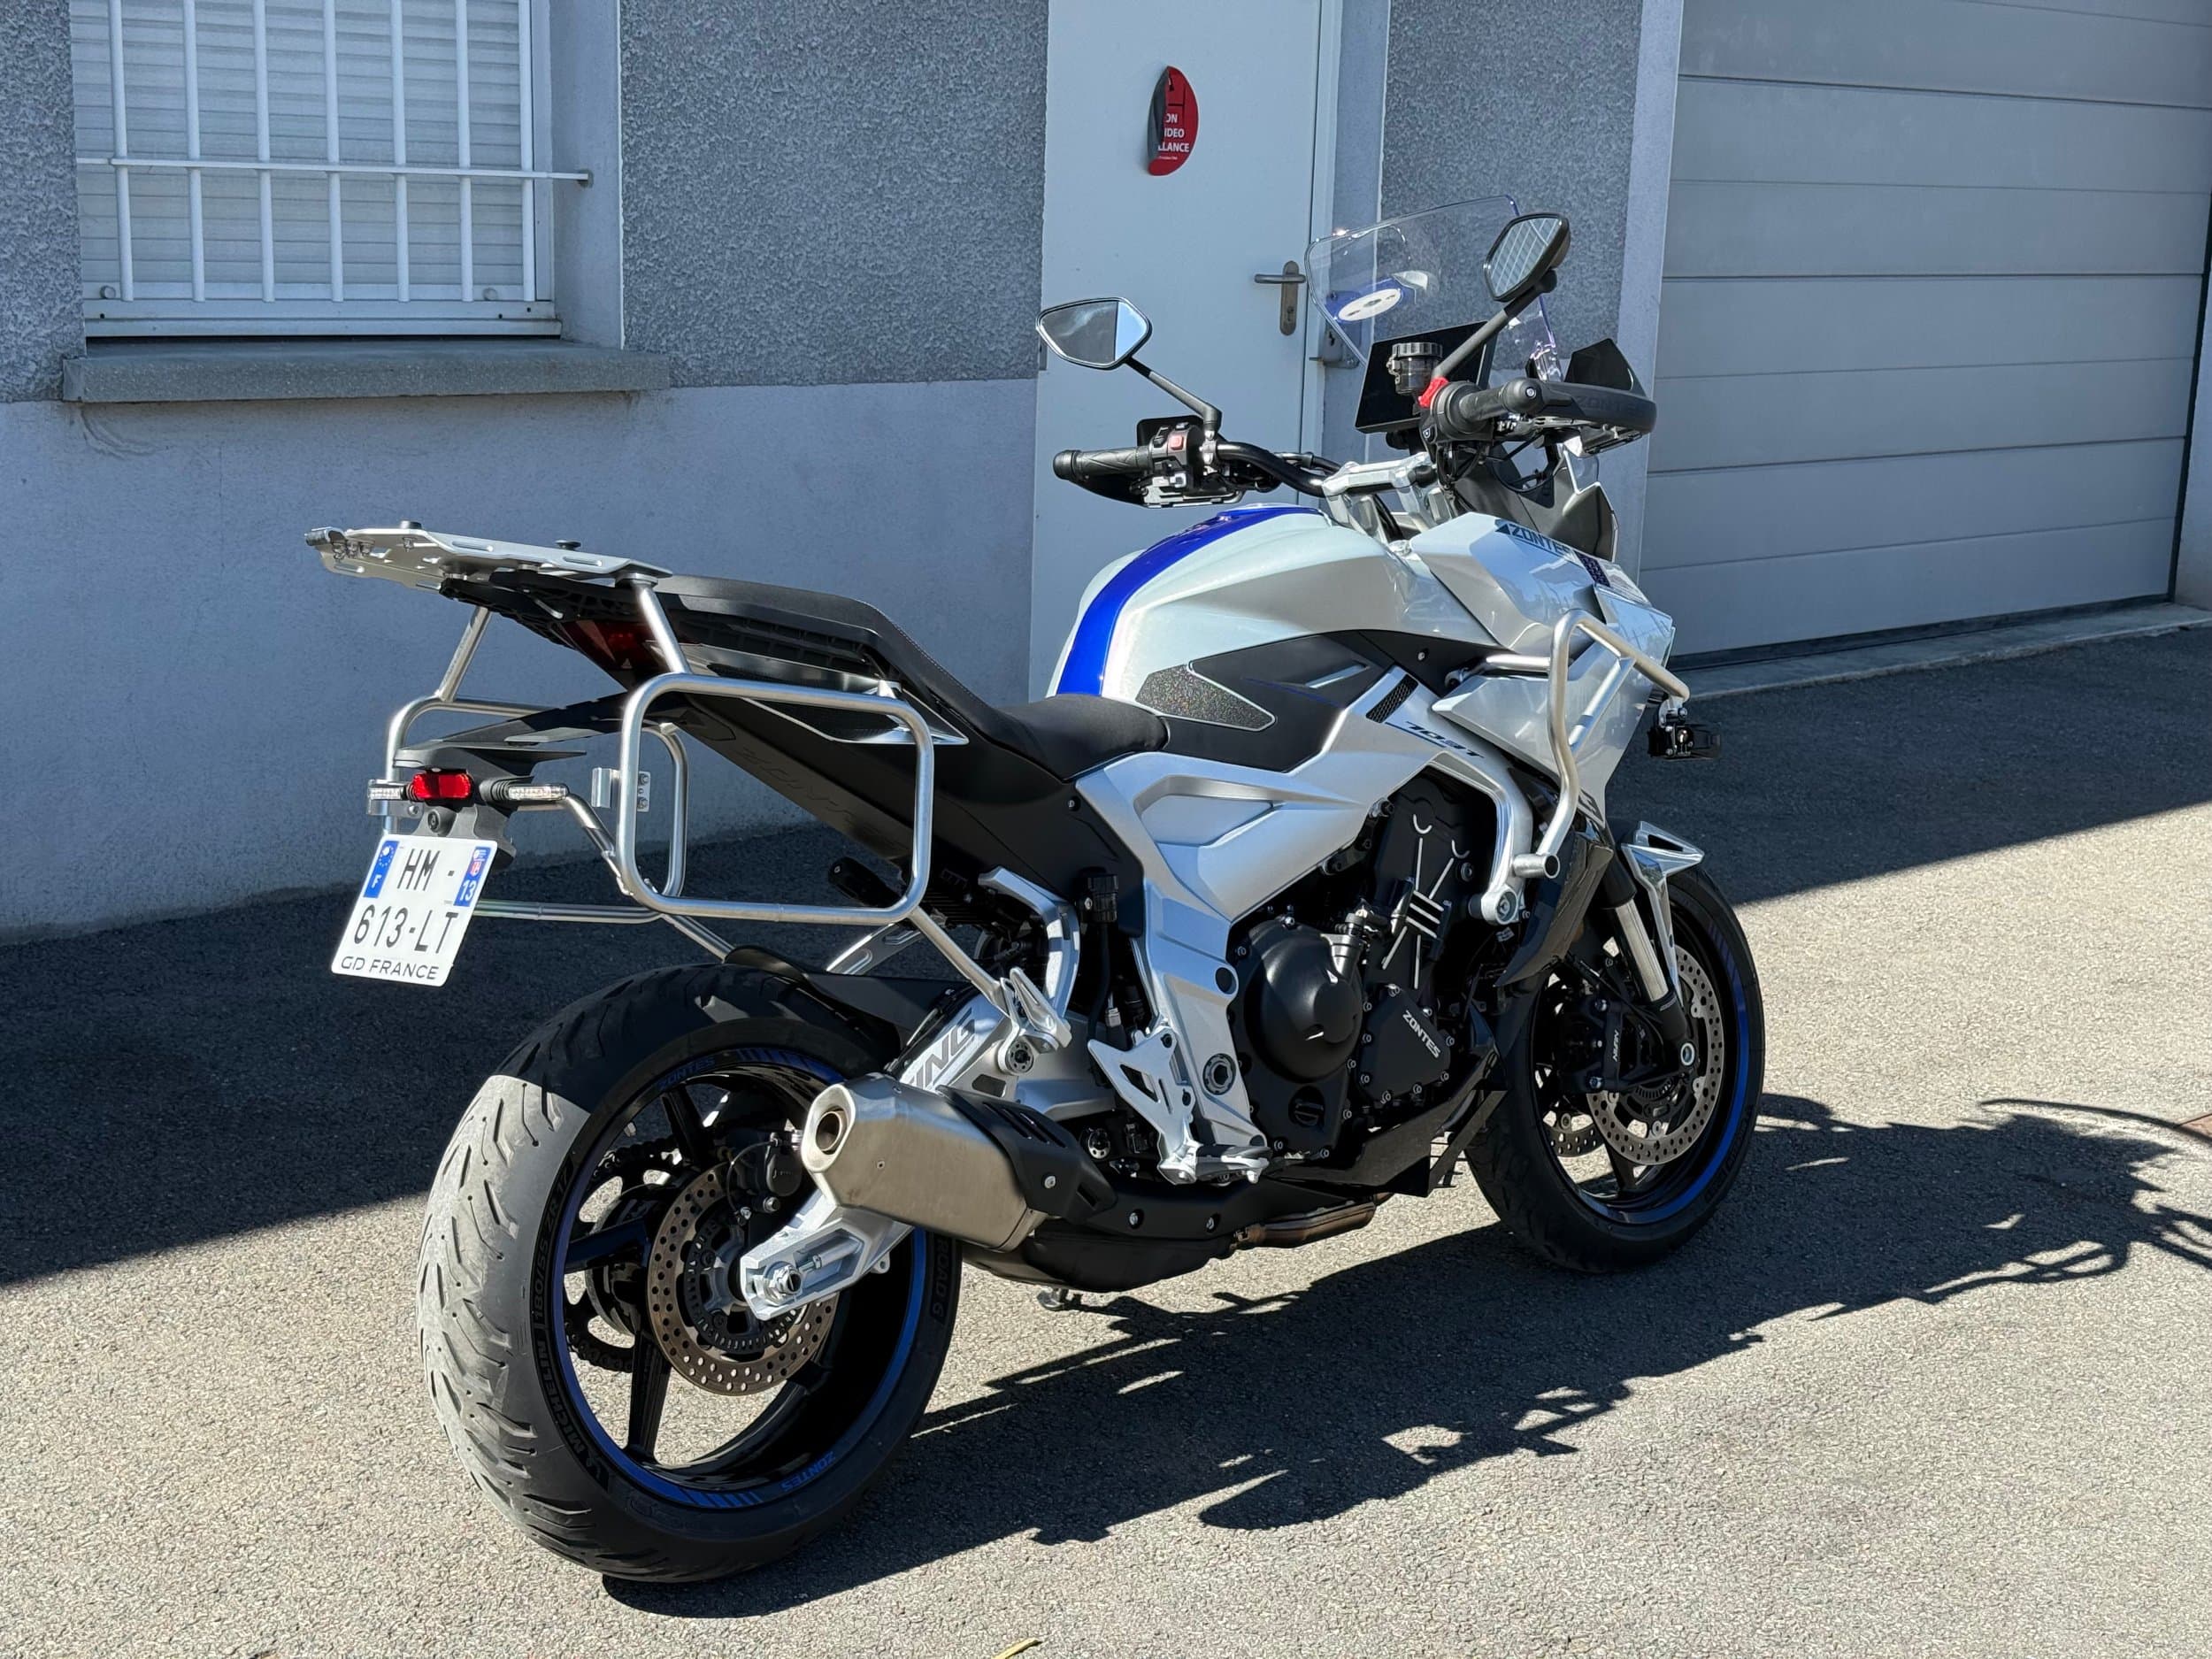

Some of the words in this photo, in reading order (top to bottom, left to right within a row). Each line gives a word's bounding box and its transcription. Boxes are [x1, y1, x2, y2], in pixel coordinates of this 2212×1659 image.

[1164, 128, 1184, 138] IDEO
[1165, 113, 1178, 123] ON
[1157, 142, 1189, 152] LLANCE
[371, 874, 382, 889] F
[459, 879, 477, 902] 13
[354, 904, 459, 954] 613-LT
[341, 956, 365, 971] GD
[369, 959, 439, 980] FRANCE
[910, 1007, 975, 1089] ING
[1402, 1008, 1441, 1059] ZONTES
[534, 1240, 549, 1320] 180/55
[934, 1239, 950, 1298] ROAD
[932, 1302, 945, 1318] 6
[537, 1340, 588, 1455] MICHELIN
[779, 1450, 836, 1493] ZONTES
